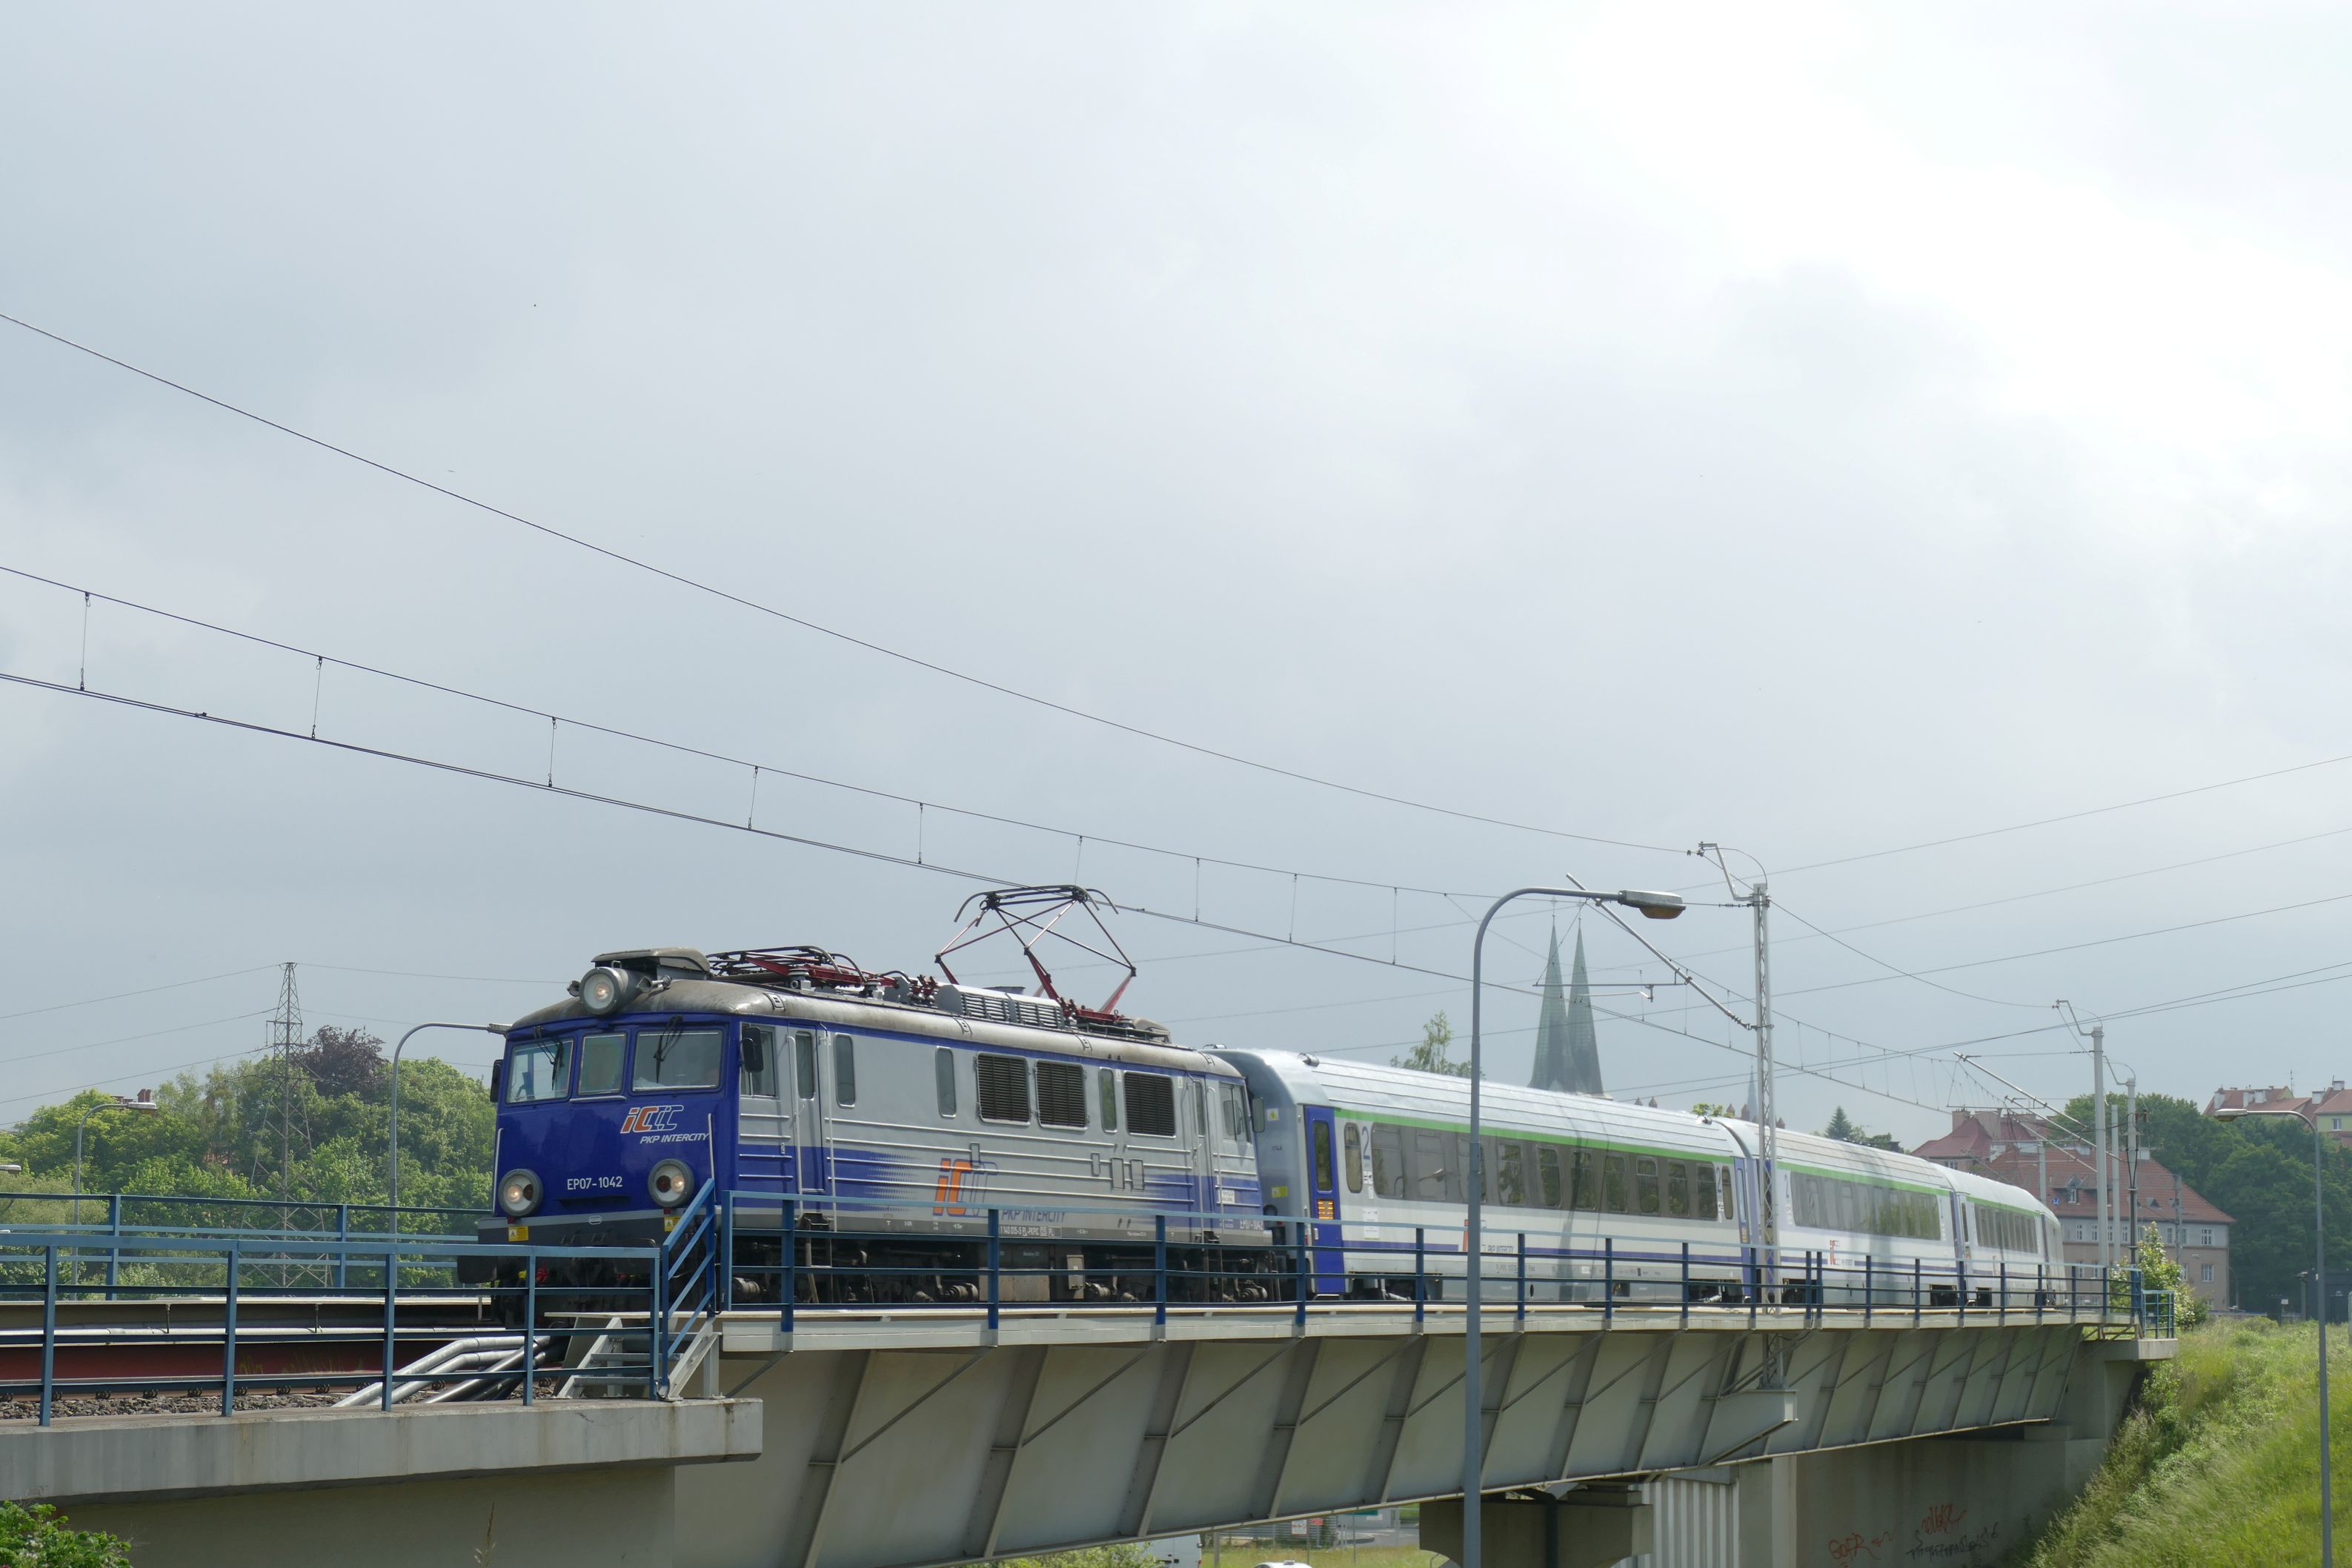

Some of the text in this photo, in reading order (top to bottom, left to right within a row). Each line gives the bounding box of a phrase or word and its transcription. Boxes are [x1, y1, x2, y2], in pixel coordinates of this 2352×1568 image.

[640, 1132, 709, 1144] PKP INTERCITY
[1362, 1126, 1370, 1160] 2
[567, 1176, 622, 1190] EP07-1042
[1001, 1209, 1020, 1220] PKP
